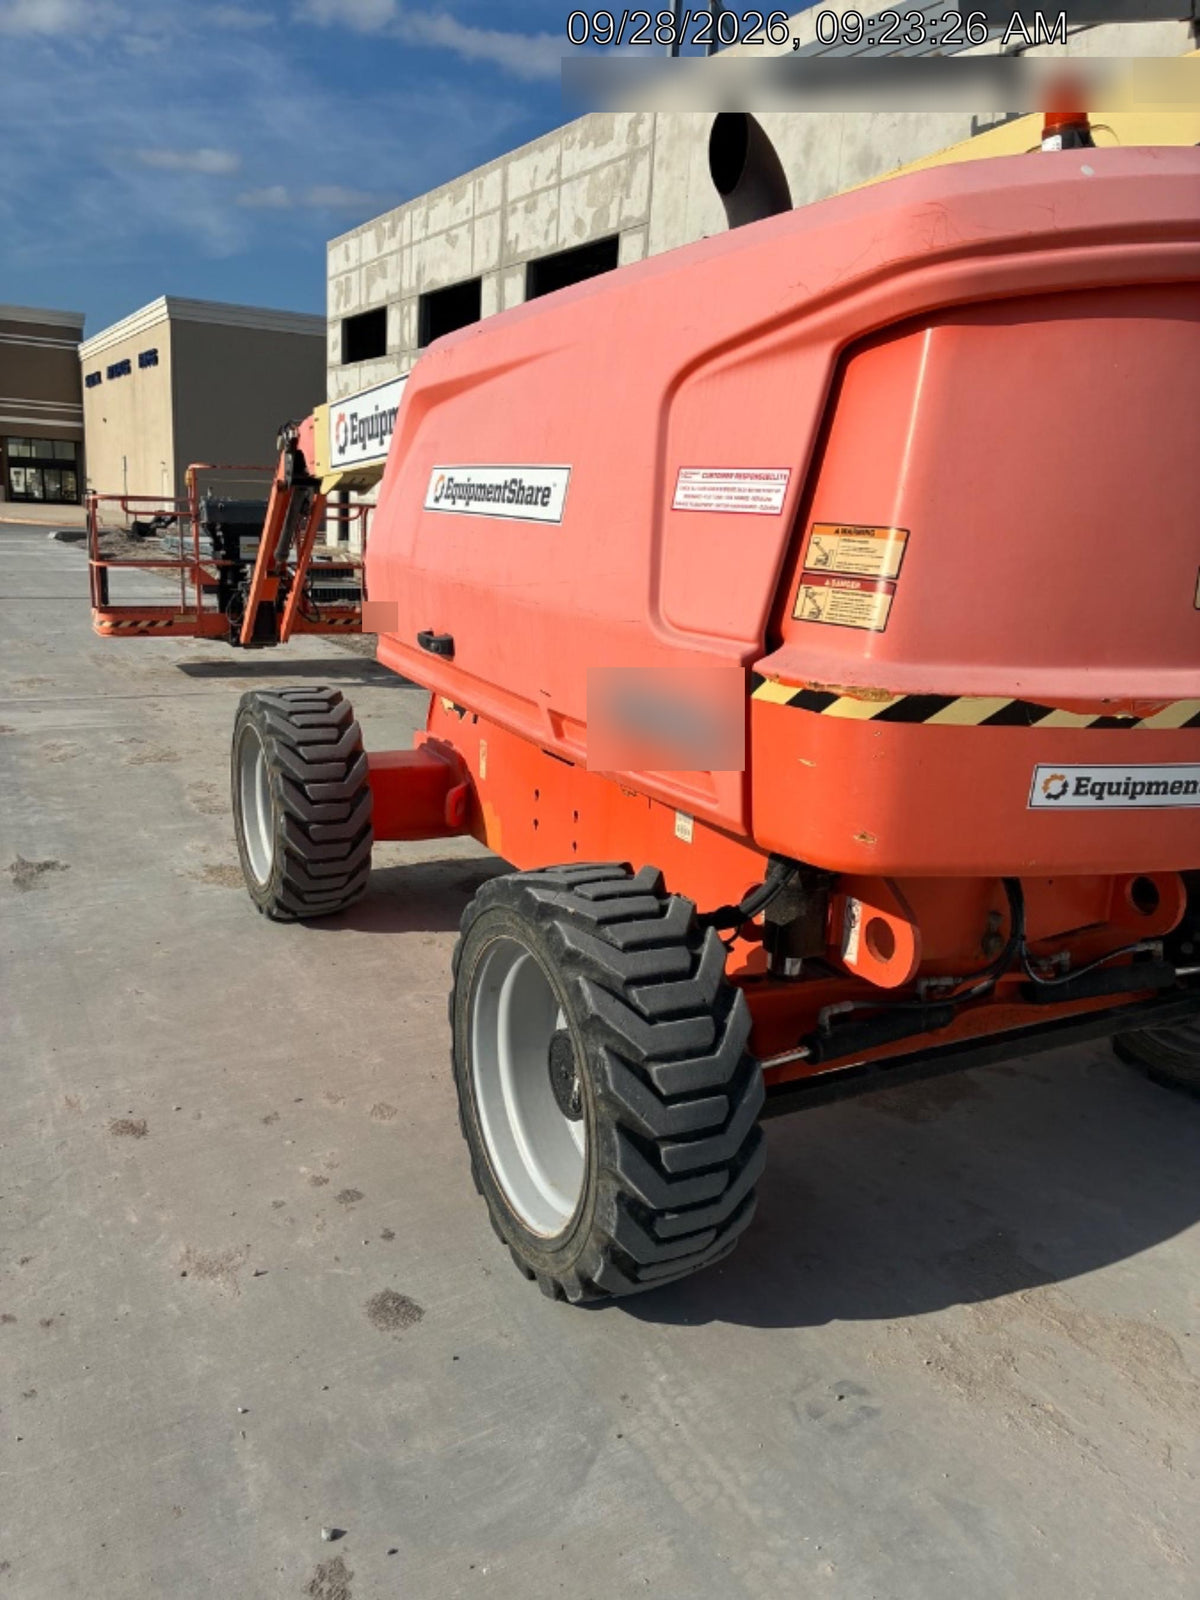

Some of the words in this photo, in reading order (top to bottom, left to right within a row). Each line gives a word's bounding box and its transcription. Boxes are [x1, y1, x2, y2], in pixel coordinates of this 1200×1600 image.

[444, 477, 552, 507] EquipmentShare
[840, 528, 876, 537] WARNING
[831, 579, 862, 589] DANGER
[1072, 777, 1200, 800] Equipmen
